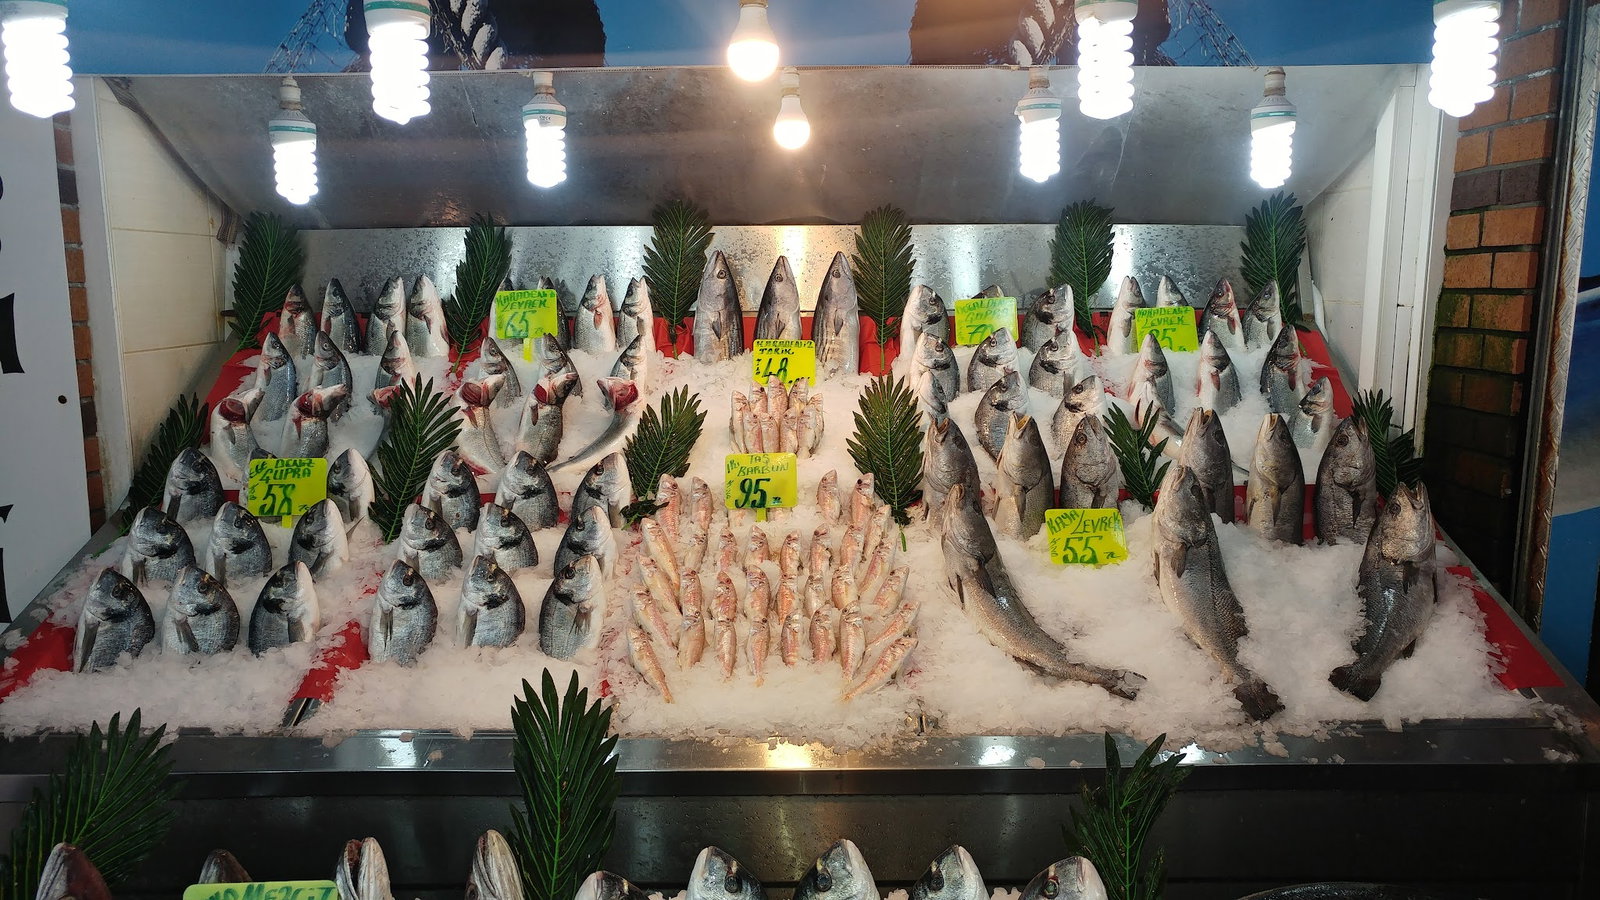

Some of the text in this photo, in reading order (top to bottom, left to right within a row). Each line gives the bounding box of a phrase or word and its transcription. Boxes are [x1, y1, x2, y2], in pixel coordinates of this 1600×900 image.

[259, 483, 296, 516] 58
[735, 478, 771, 508] 95
[1047, 509, 1122, 535] KAYA LEVREK
[1063, 535, 1103, 564] 55
